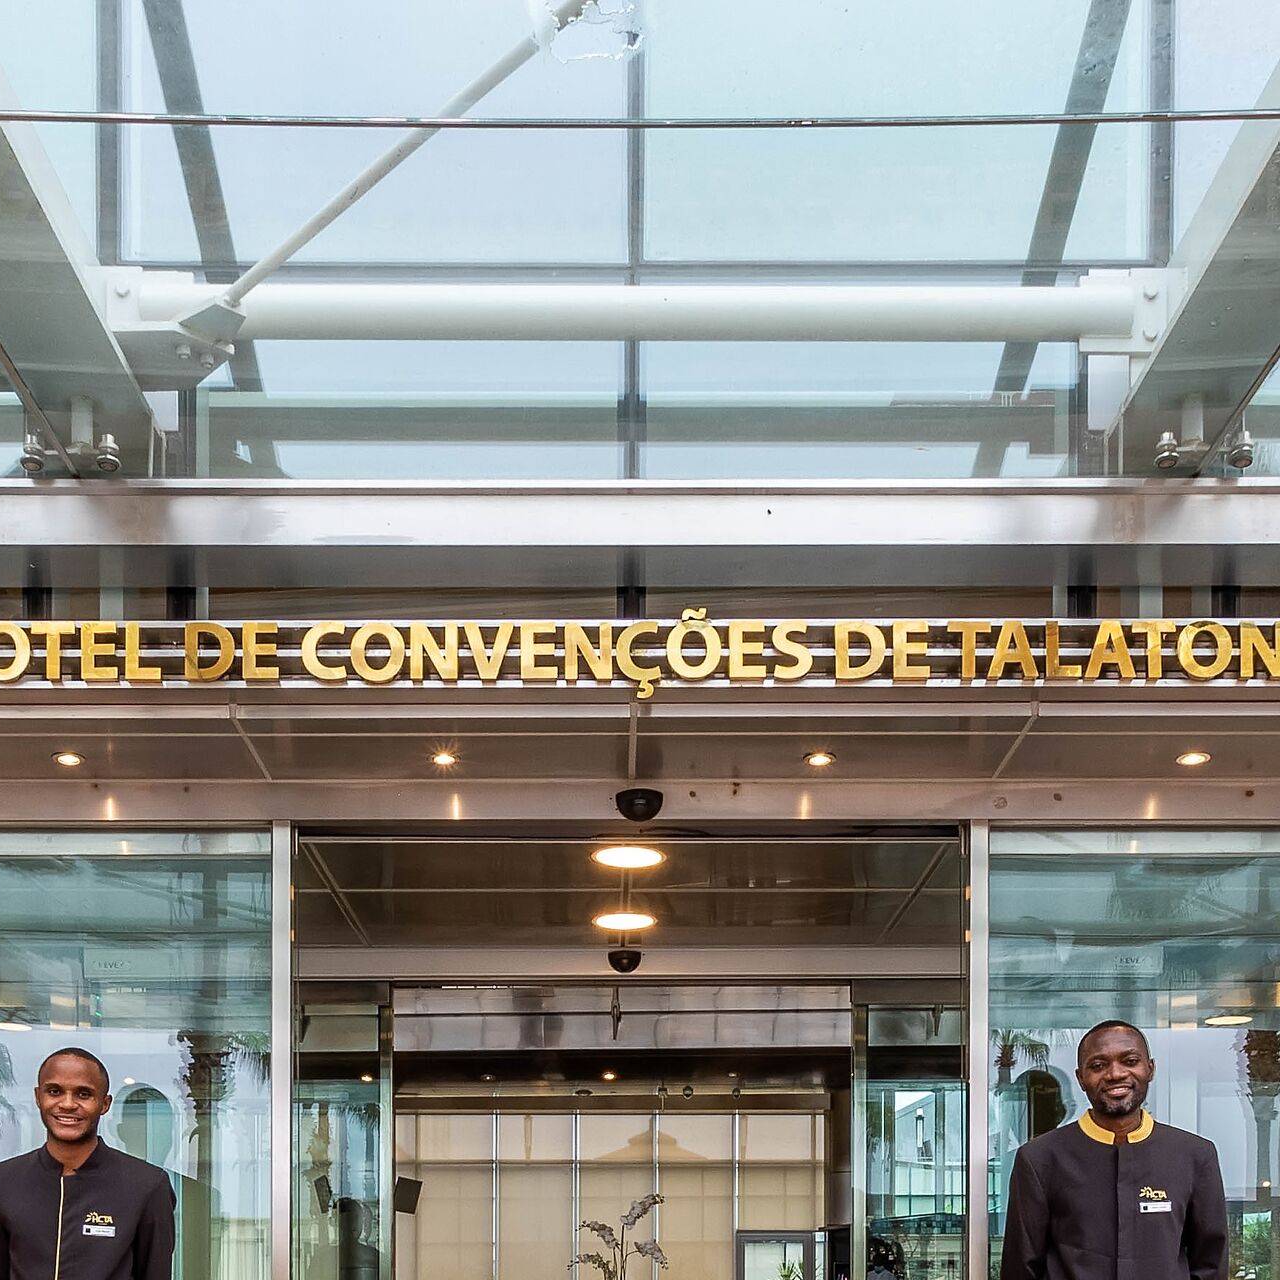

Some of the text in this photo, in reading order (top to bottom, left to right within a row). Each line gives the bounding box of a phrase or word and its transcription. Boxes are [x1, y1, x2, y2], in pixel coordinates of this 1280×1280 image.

[185, 621, 280, 683] DE
[301, 607, 814, 698] CONVENÇÕES
[834, 620, 931, 681] DE
